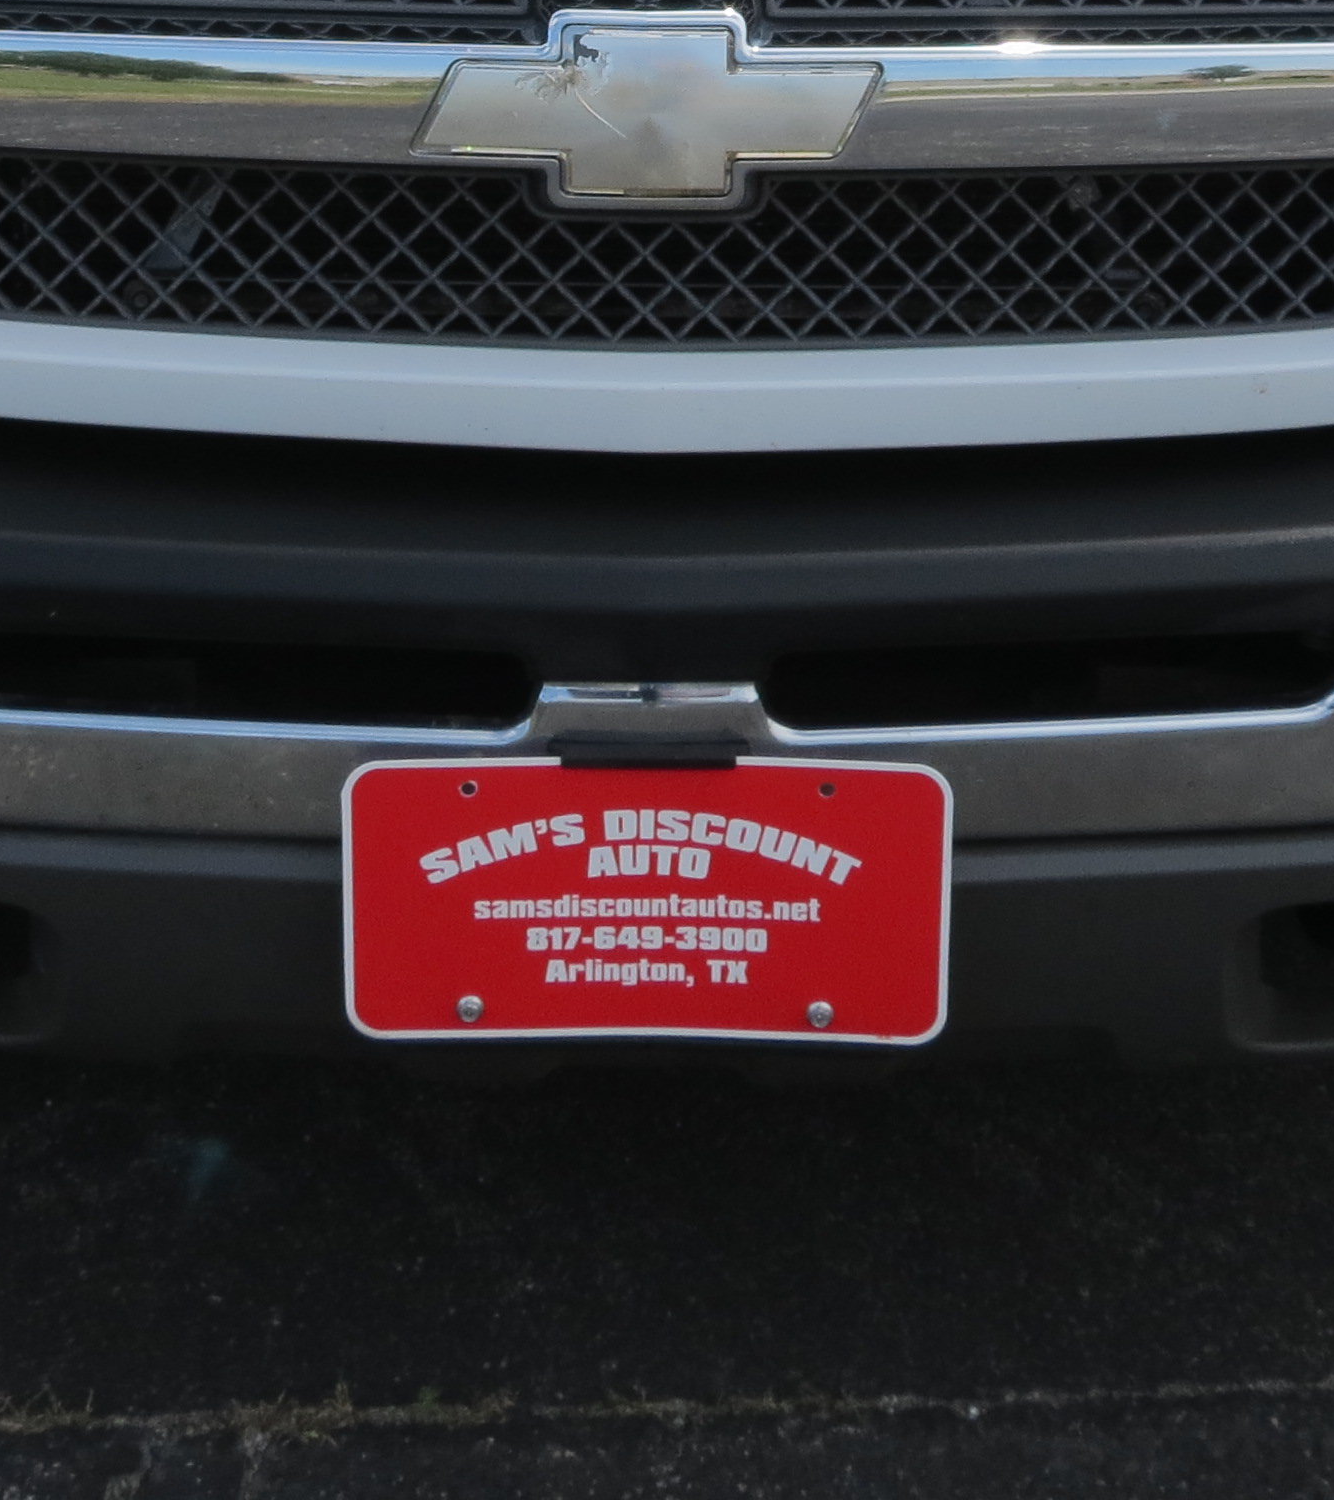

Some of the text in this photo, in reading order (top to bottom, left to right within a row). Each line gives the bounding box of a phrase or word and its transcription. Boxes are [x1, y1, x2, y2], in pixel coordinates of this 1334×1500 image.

[420, 810, 862, 884] SAM'S DISCOUNT
[588, 846, 710, 879] AUTO
[474, 894, 820, 921] samsdiscountautos.net
[527, 927, 767, 952] 817-649-3900
[546, 959, 747, 986] Arlington, TX
